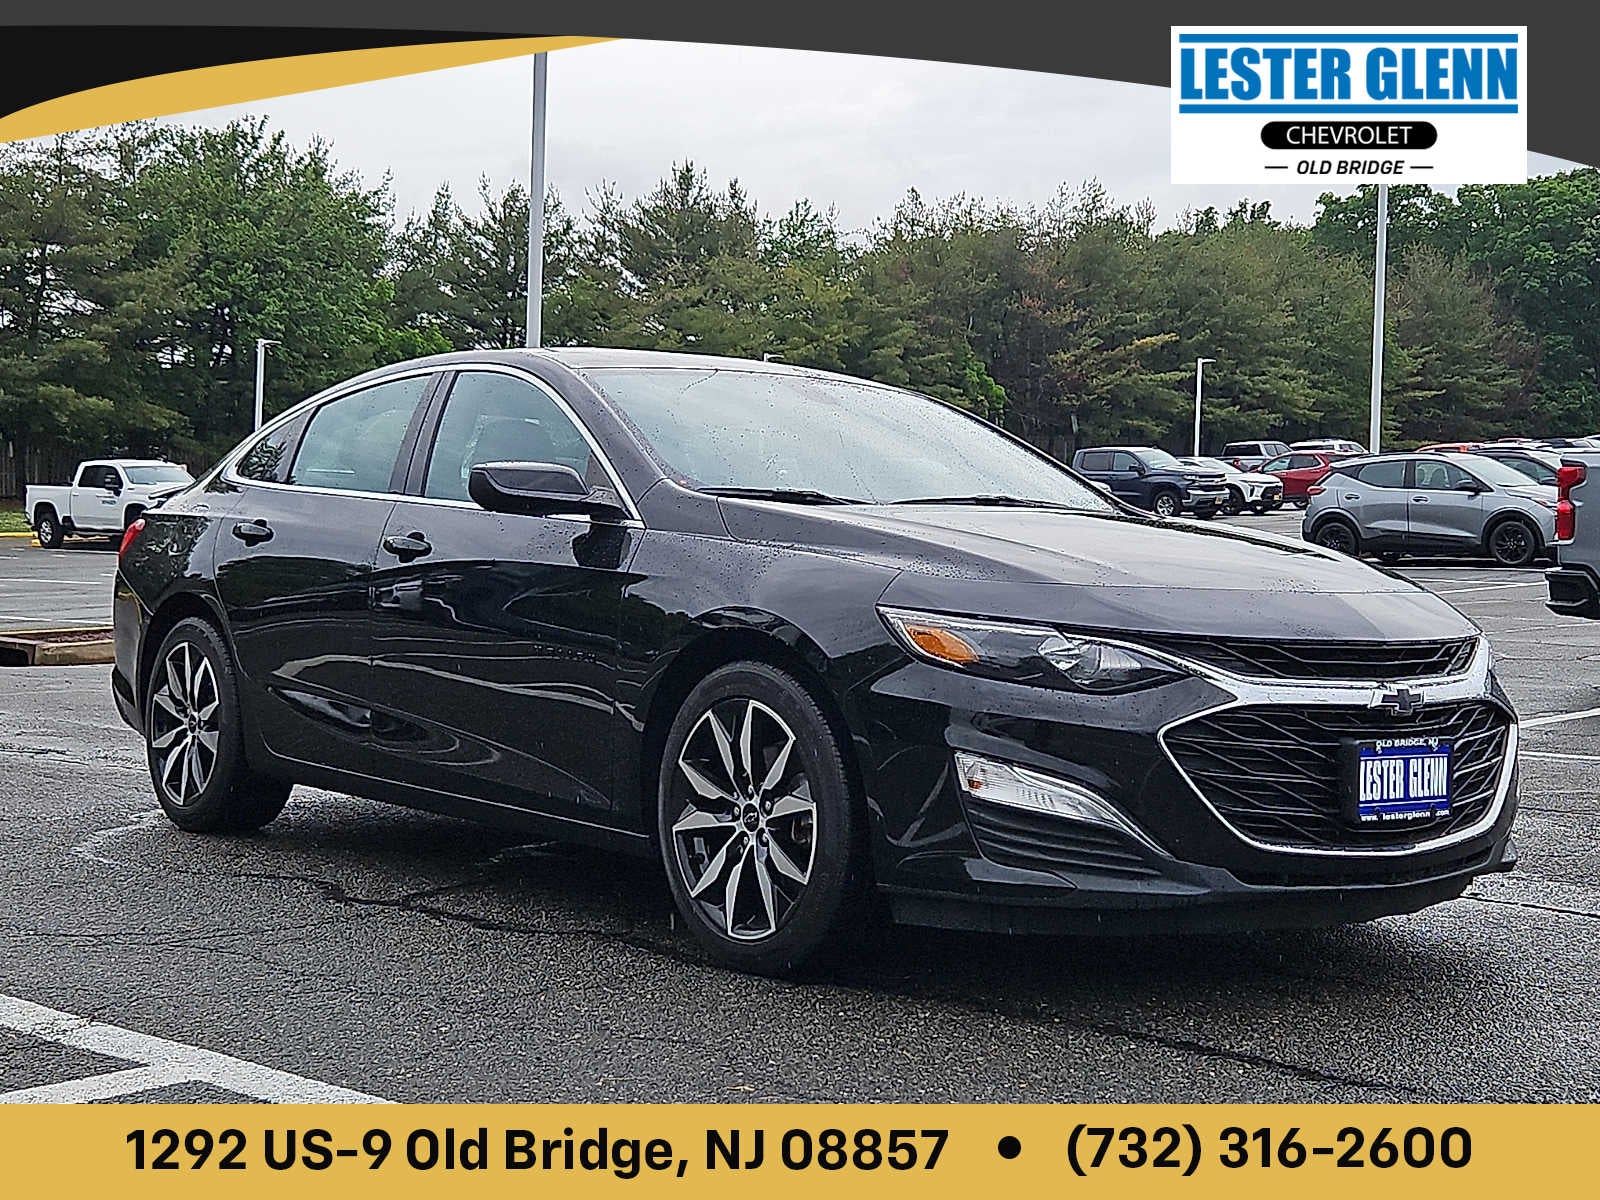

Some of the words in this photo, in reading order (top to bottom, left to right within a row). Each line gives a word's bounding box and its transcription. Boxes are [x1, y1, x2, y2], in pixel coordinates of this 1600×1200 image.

[1376, 739, 1392, 747] OLD
[1359, 759, 1404, 801] LESTER
[1409, 757, 1447, 798] GLENN
